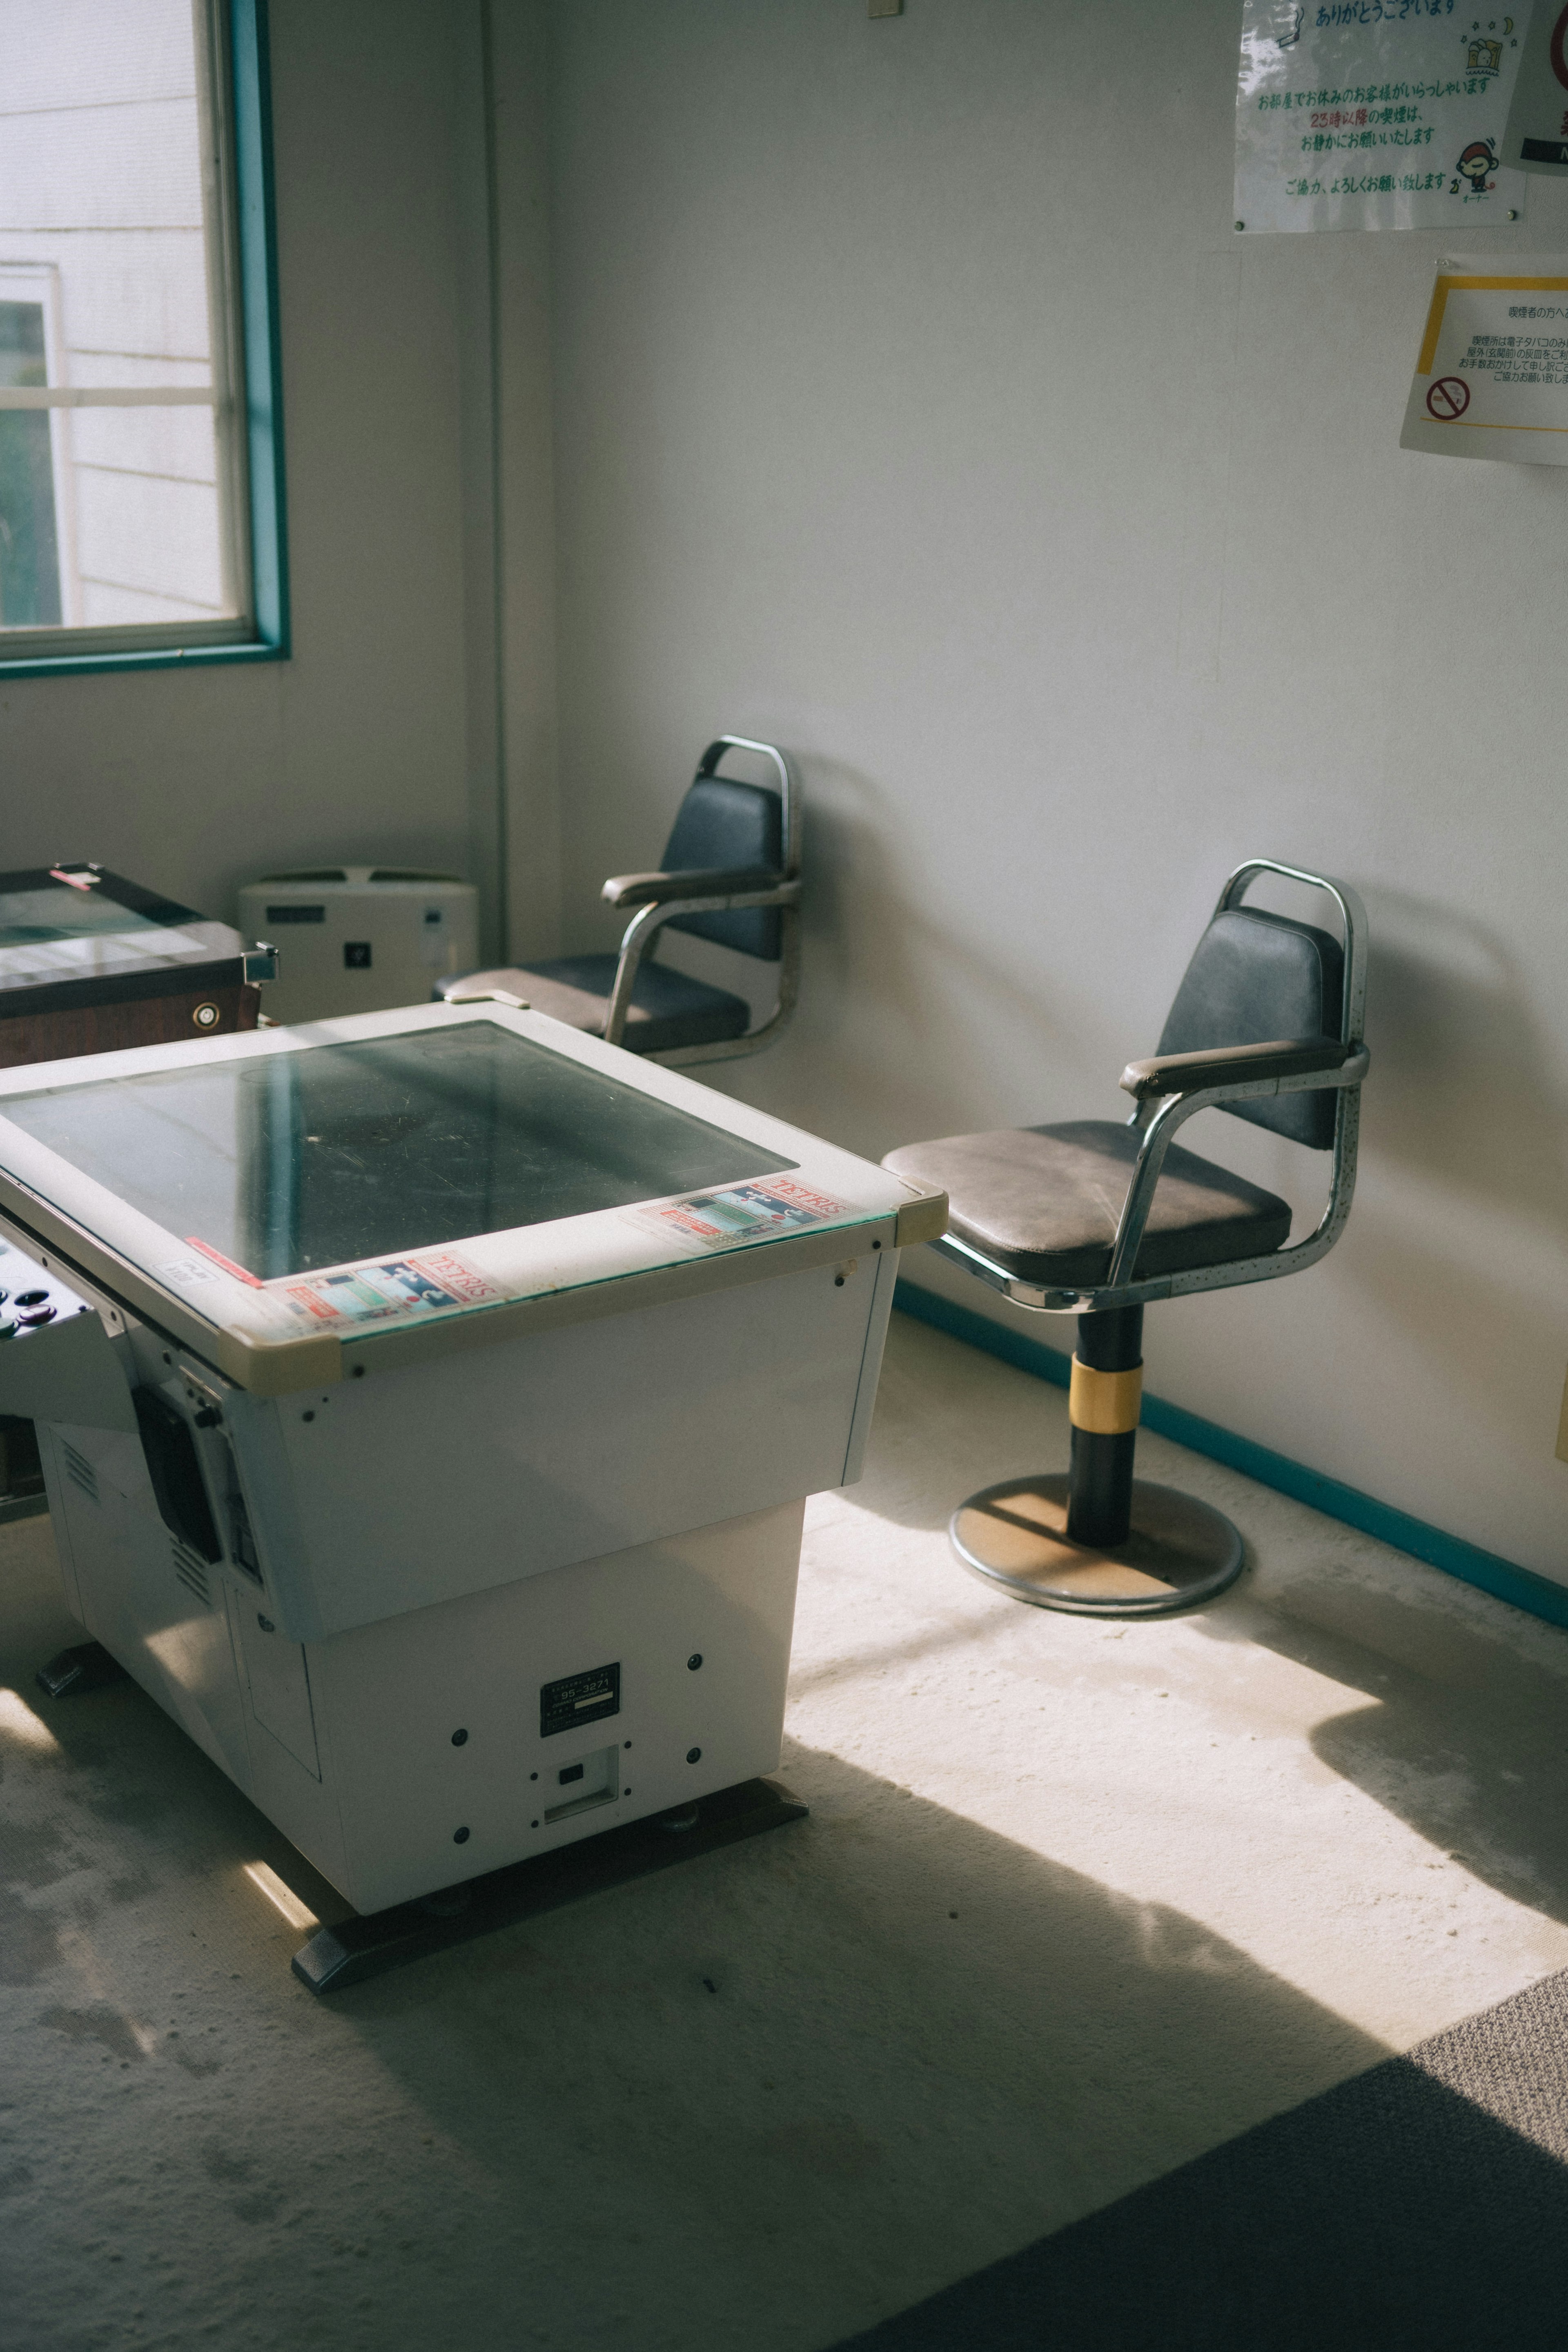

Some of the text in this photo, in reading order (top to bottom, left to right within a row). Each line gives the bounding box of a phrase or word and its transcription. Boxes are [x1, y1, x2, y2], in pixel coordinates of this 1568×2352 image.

[1316, 0, 1454, 26] ありがとうございます
[1258, 78, 1490, 110] お部屋でお休みのお客様がいらっしゃいます
[1301, 127, 1434, 151] お静かにお願いいたします
[1286, 172, 1446, 195] ご協力、よろしくお願い致します
[1463, 195, 1489, 203] オーナー
[1467, 347, 1568, 360] 屋外(玄関前)の灰皿をご利
[1472, 336, 1568, 348] 喫煙所は電子タバコのみ
[770, 1180, 848, 1214] TETRIS
[428, 1255, 497, 1296] TETRIS
[552, 1688, 608, 1708] COSMO CORPORATION
[561, 1678, 608, 1699] 95-3271
